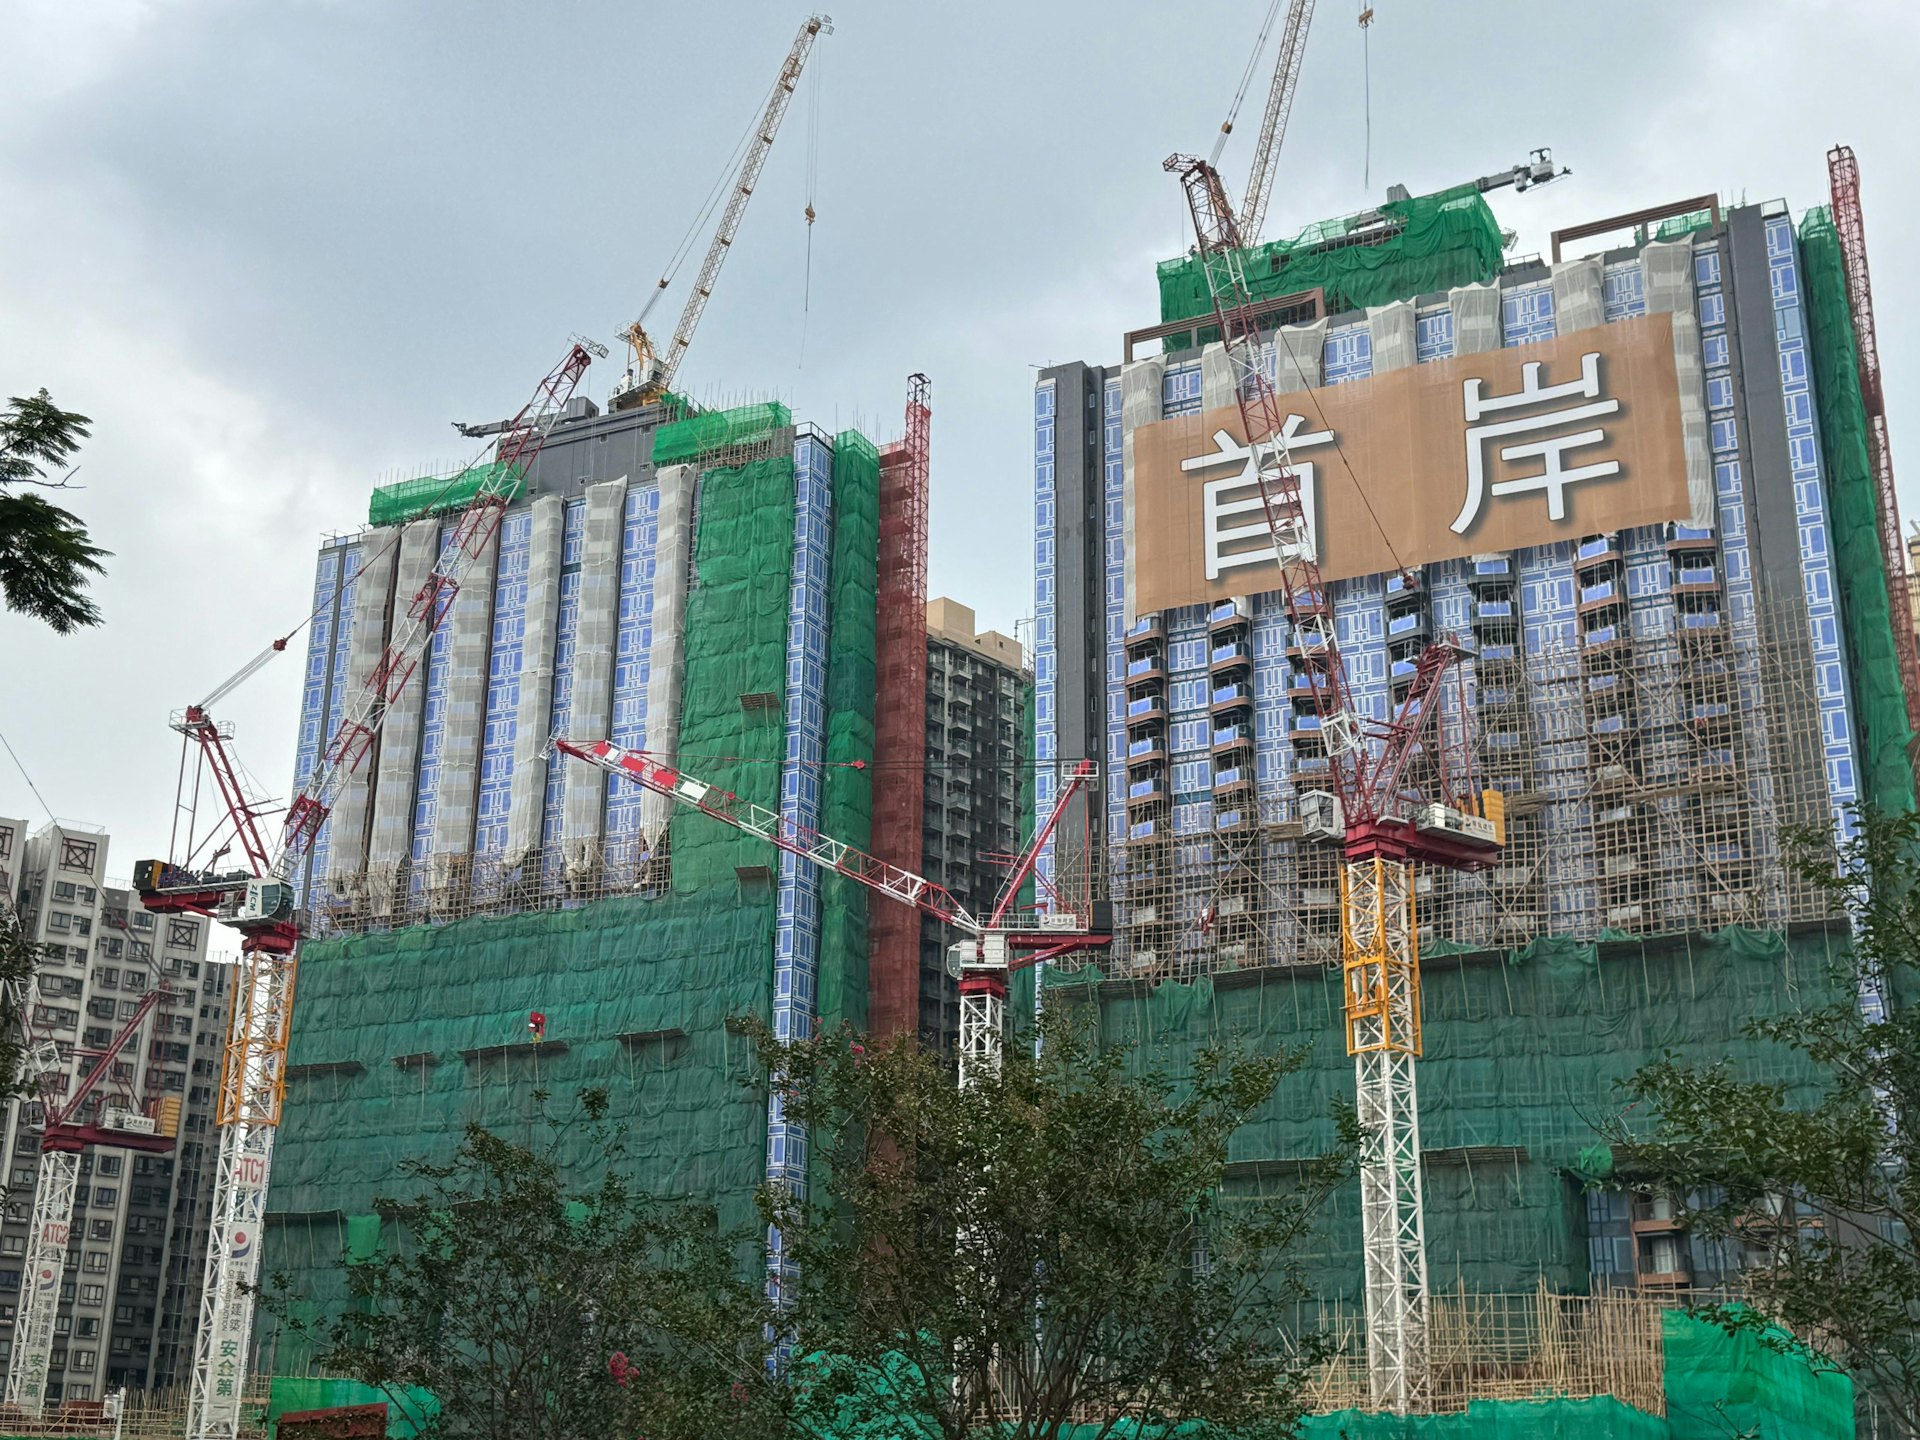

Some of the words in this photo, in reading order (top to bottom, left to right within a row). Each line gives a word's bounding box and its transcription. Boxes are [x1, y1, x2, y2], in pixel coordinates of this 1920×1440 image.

[1180, 352, 1620, 581] 首岸
[235, 1157, 265, 1183] ATC1
[43, 1223, 69, 1245] ATC2
[213, 1339, 239, 1409] 安全第一
